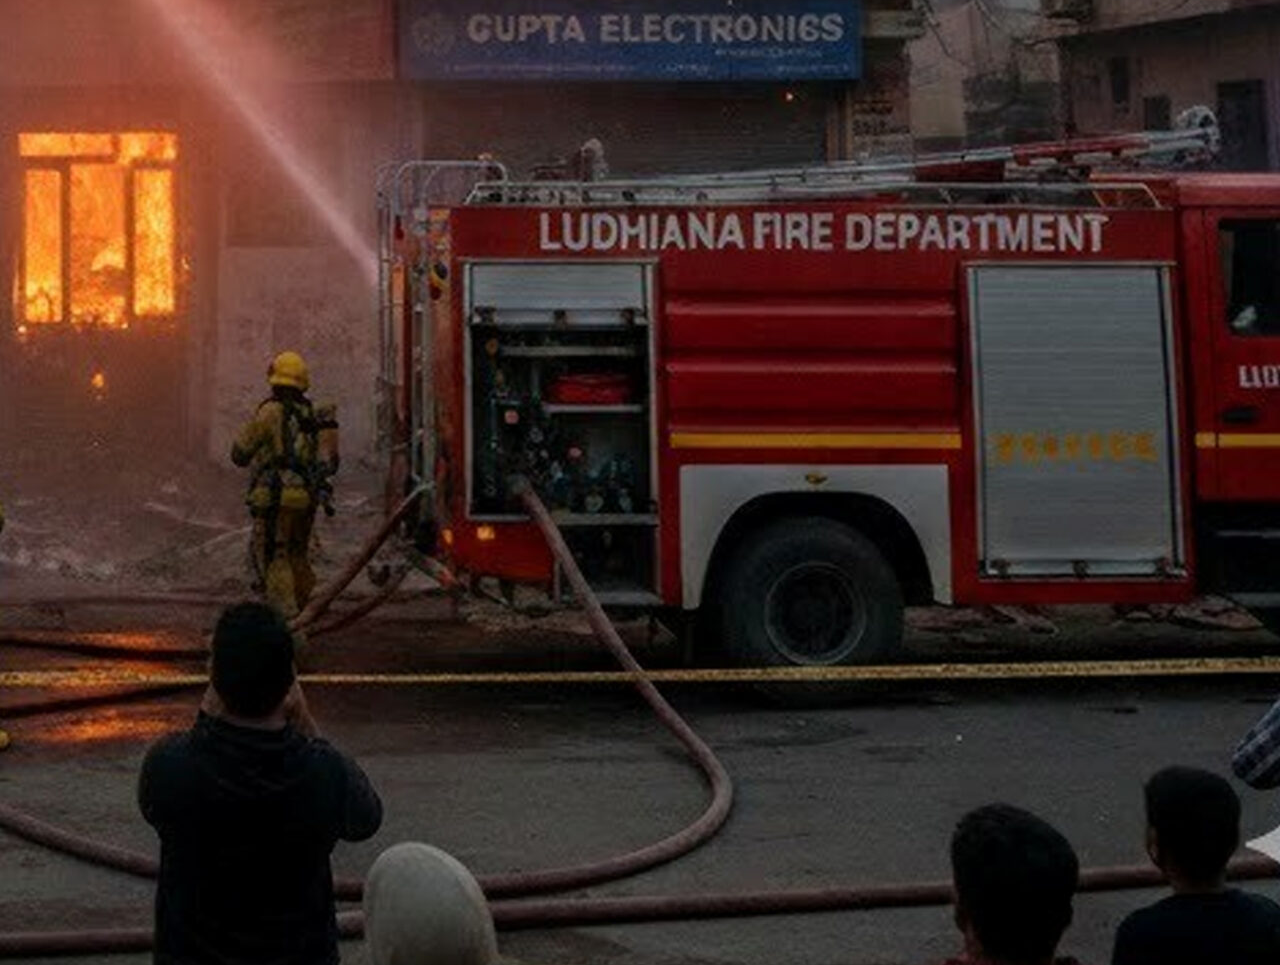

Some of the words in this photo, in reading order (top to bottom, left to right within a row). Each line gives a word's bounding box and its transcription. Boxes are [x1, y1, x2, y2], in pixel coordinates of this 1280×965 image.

[539, 211, 745, 251] LUDHIANA
[752, 212, 834, 251] FIRE
[845, 213, 1110, 253] DEPARTMENT
